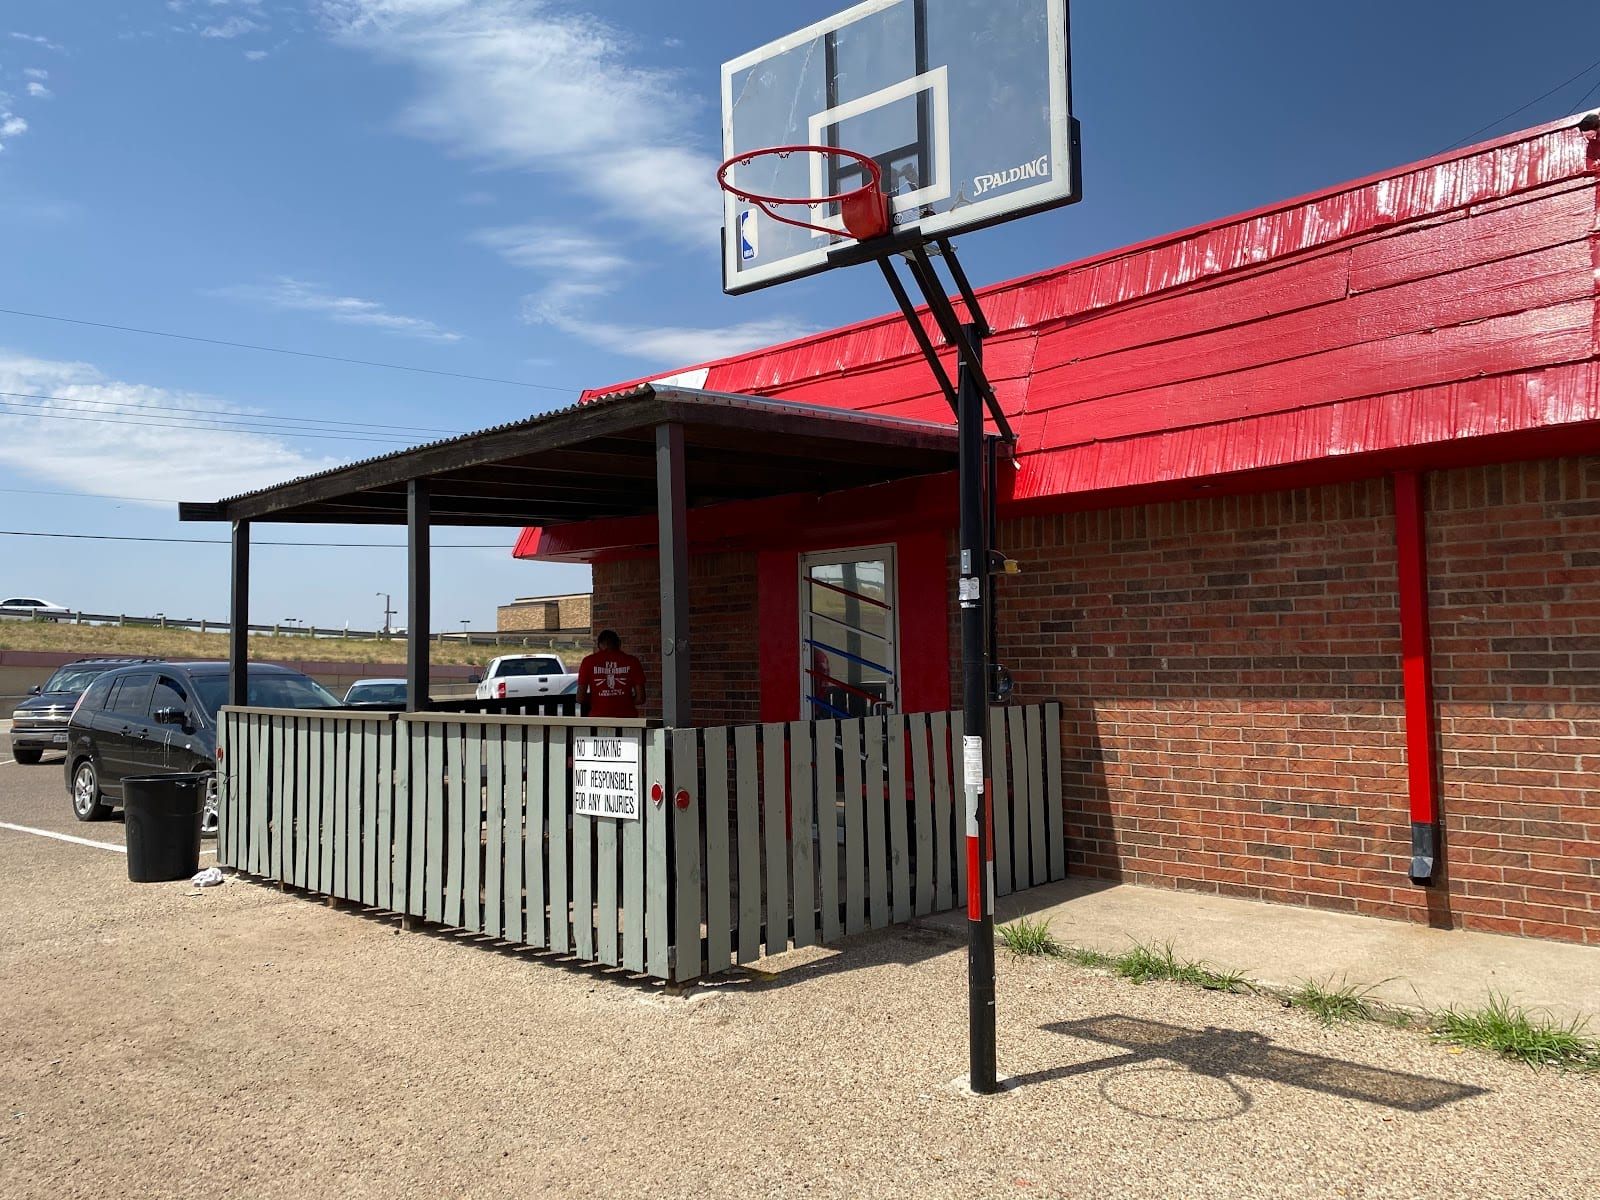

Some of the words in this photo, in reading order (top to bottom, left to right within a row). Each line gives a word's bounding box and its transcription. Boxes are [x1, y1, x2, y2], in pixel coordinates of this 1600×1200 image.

[973, 154, 1049, 197] SPALDING
[576, 739, 586, 757] NO
[593, 739, 621, 757] DUNKING
[575, 769, 587, 787] NOT
[590, 770, 634, 791] RESPONSIBLE
[575, 792, 586, 810] FOR
[588, 793, 601, 812] ANY
[604, 794, 635, 814] INJURIES
